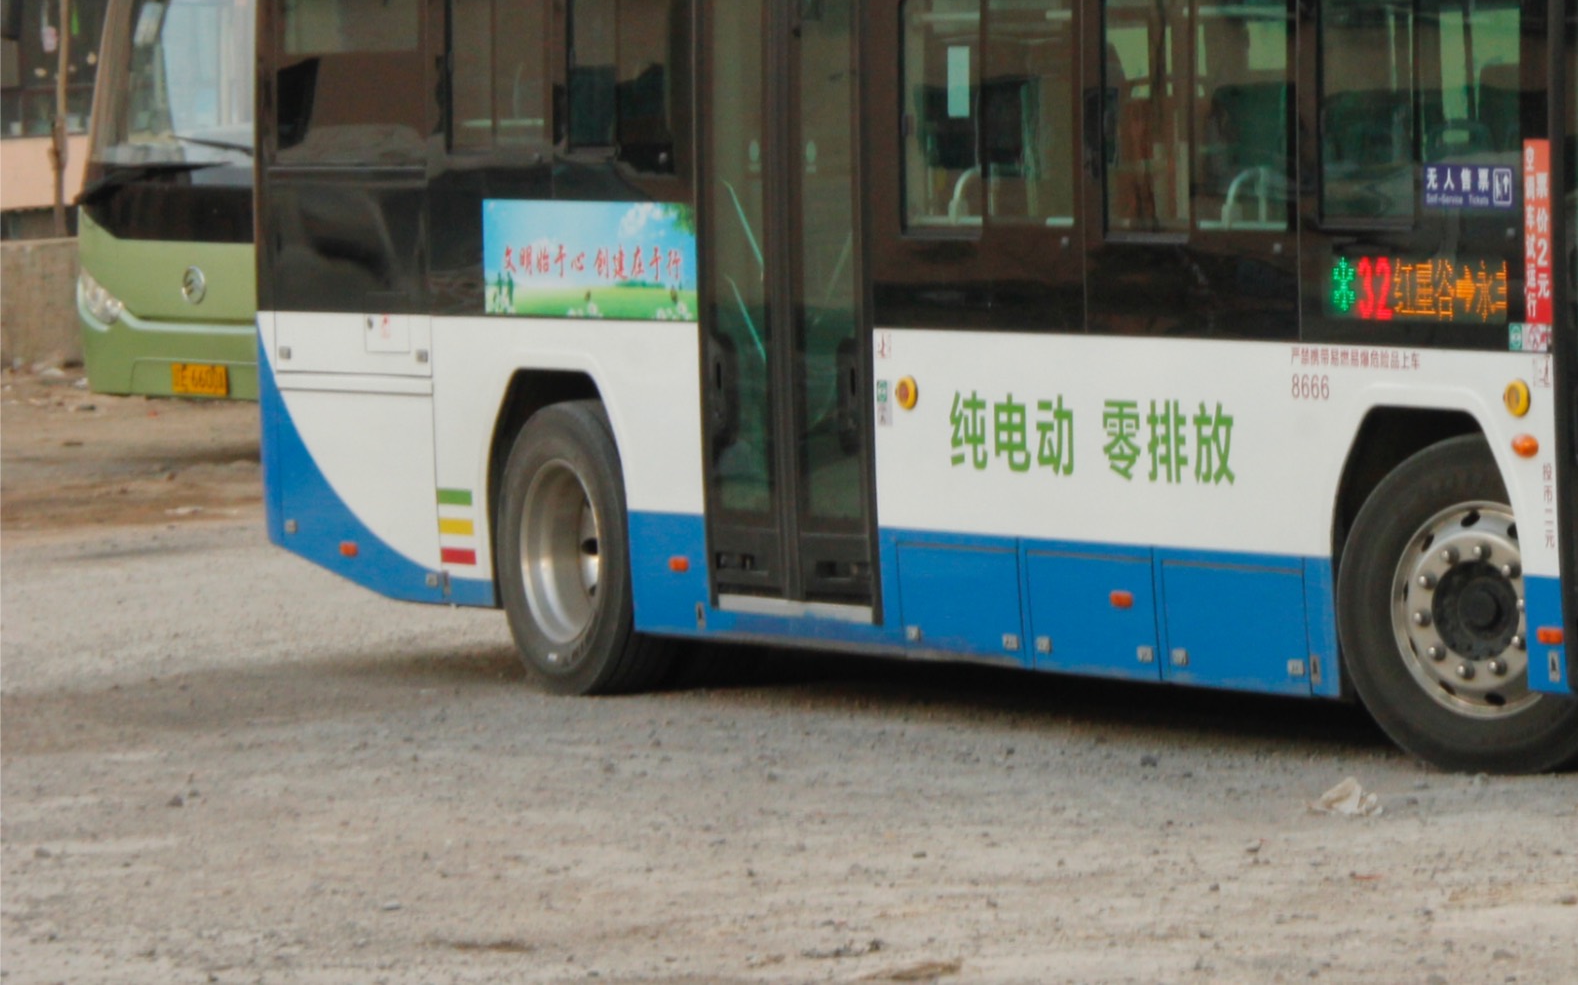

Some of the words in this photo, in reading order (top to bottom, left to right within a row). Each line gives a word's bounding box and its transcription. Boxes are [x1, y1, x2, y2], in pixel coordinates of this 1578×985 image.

[1426, 167, 1490, 192] 无人售票
[1536, 172, 1551, 298] 票价2元
[1358, 256, 1393, 320] 32
[1393, 258, 1455, 321] 红星谷
[1291, 373, 1330, 401] 8666
[950, 390, 1075, 477] 纯电动
[1101, 399, 1236, 487] 零排放
